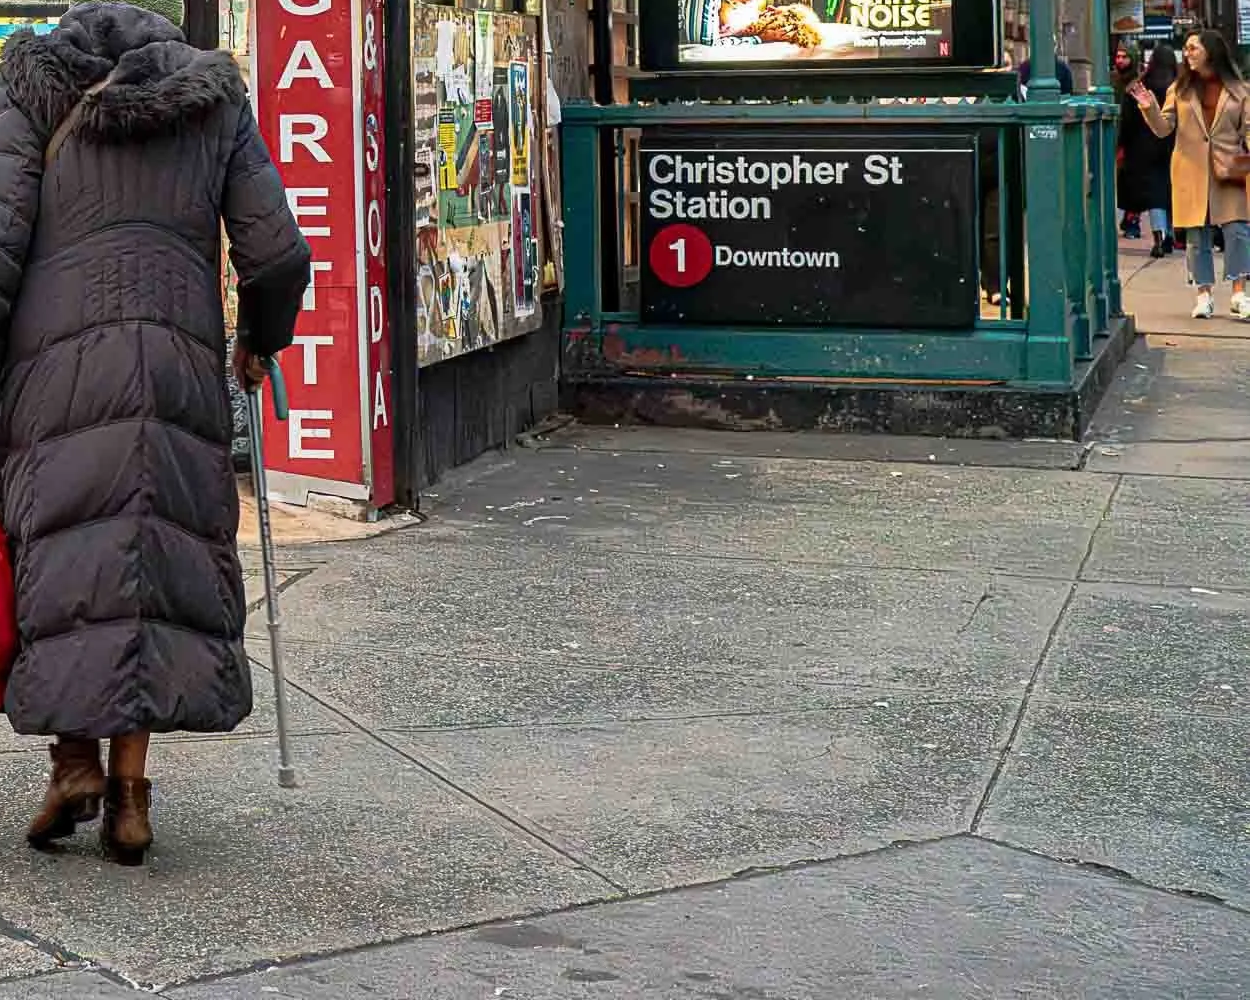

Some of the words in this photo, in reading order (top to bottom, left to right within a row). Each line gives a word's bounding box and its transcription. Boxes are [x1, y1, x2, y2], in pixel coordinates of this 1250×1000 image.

[849, 4, 931, 28] NOISE
[649, 154, 848, 190] Christopher
[862, 154, 903, 185] St
[649, 188, 771, 220] Station
[366, 113, 389, 430] SODA
[669, 238, 687, 273] 1
[715, 245, 840, 269] Downtown
